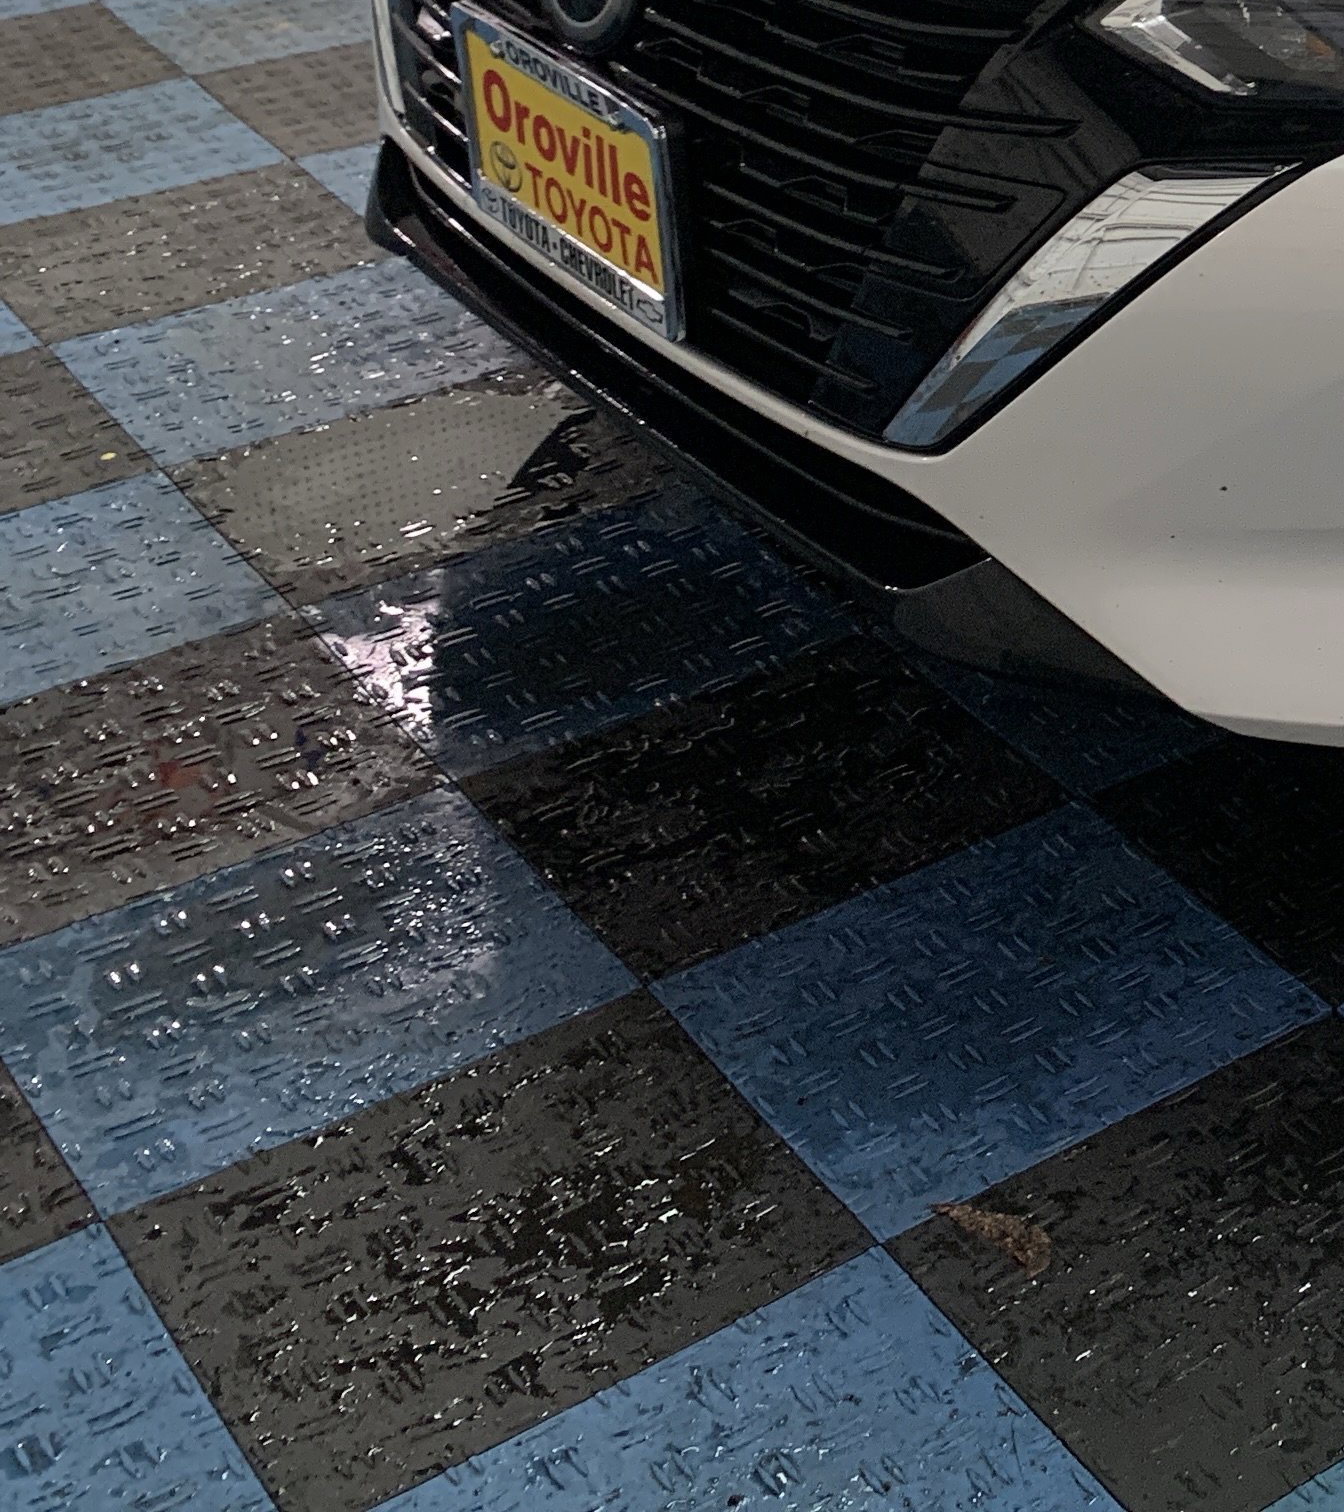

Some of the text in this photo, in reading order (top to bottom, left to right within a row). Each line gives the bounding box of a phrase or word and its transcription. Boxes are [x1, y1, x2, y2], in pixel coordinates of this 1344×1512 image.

[507, 41, 603, 115] OROVILLE
[483, 69, 651, 222] Oroville
[524, 161, 660, 286] TOYOTA
